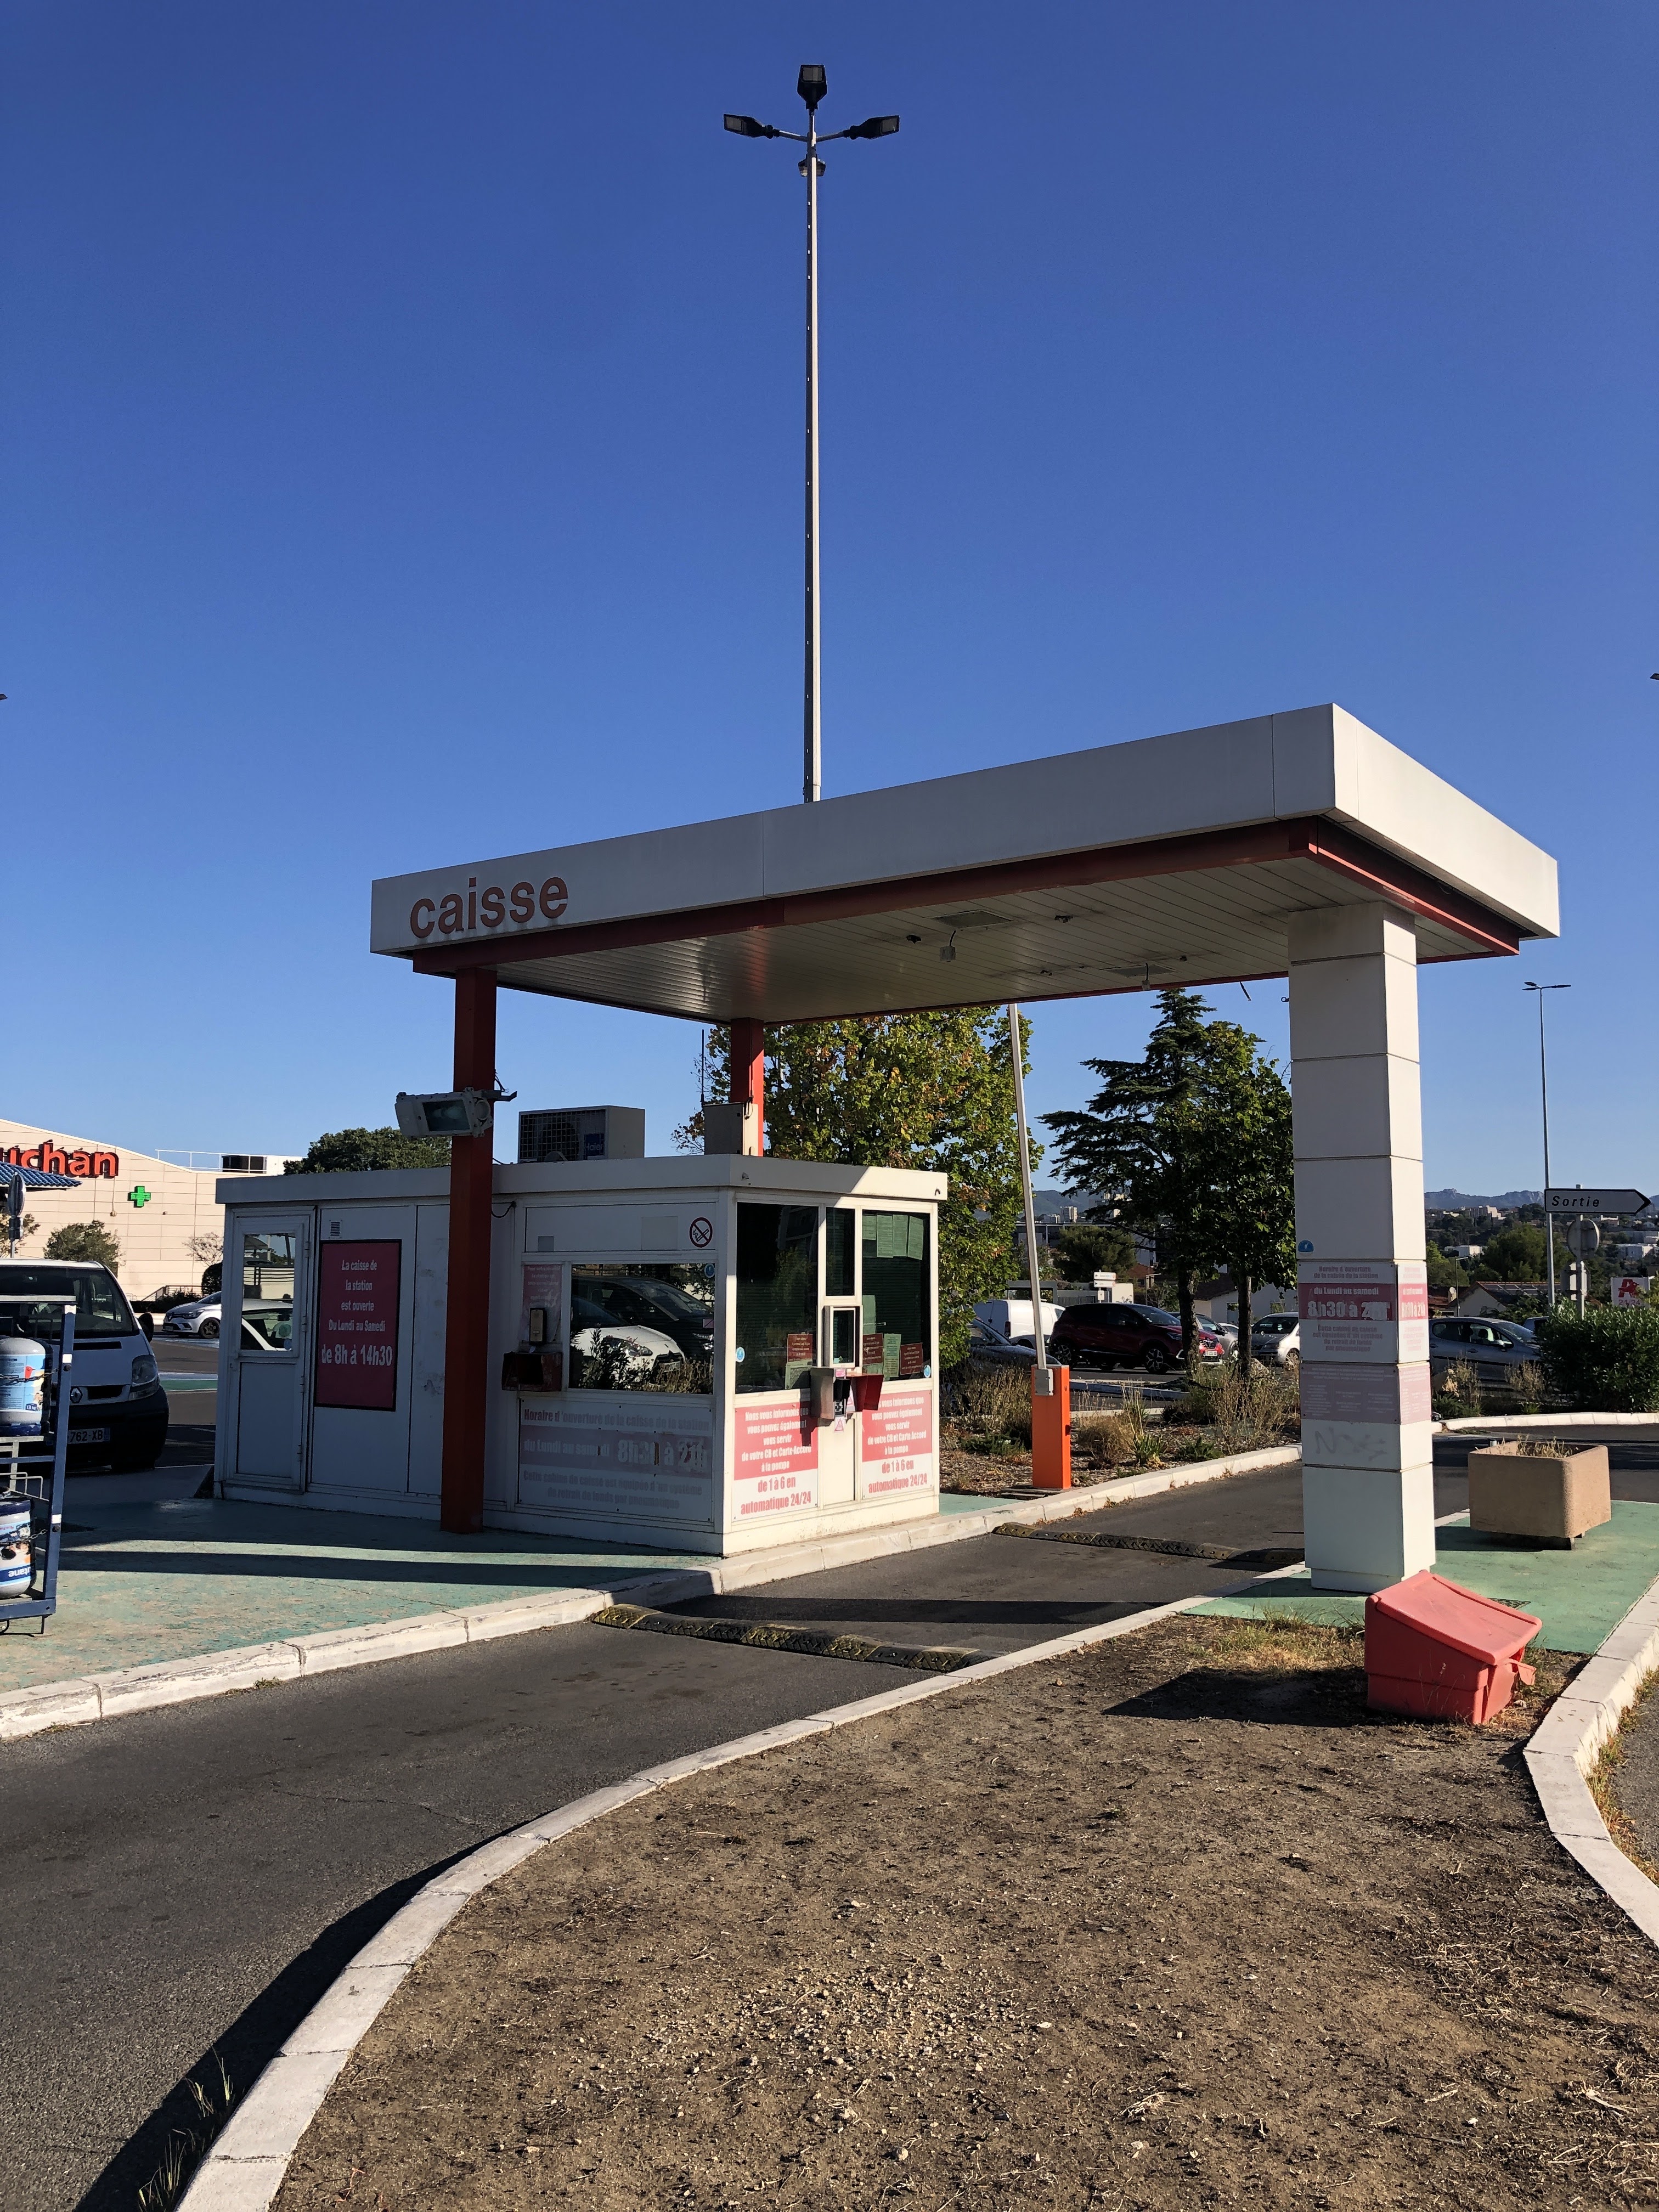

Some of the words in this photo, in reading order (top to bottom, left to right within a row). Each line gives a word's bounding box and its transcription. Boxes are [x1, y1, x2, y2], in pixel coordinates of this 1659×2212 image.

[410, 877, 568, 939] caisse
[1551, 1195, 1599, 1207] Sortie
[341, 1260, 349, 1270] La
[351, 1261, 369, 1270] caisse
[370, 1260, 377, 1270] de
[346, 1279, 351, 1290] la
[352, 1280, 373, 1291] station
[341, 1301, 351, 1311] est
[352, 1301, 374, 1311] ouverte
[1308, 1301, 1345, 1317] 8h30
[1349, 1301, 1358, 1317] à
[329, 1319, 337, 1330] Du
[338, 1319, 354, 1331] Lundi
[356, 1322, 363, 1331] au
[364, 1320, 385, 1331] Samedi
[321, 1344, 332, 1363] de
[335, 1345, 347, 1364] 8h
[350, 1345, 357, 1364] à
[360, 1345, 392, 1366] 14h30
[882, 1399, 893, 1407] vous
[893, 1397, 915, 1406] informons
[916, 1396, 924, 1406] que
[524, 1409, 553, 1421] Horaire
[604, 1413, 614, 1425] de
[617, 1414, 625, 1426] la
[626, 1414, 654, 1427] caisse
[656, 1416, 667, 1429] de
[668, 1417, 677, 1430] la
[678, 1417, 709, 1430] station
[745, 1412, 759, 1421] Nous
[760, 1411, 772, 1420] vous
[774, 1409, 799, 1418] informons
[800, 1407, 809, 1416] que
[872, 1412, 882, 1420] vous
[883, 1410, 899, 1420] pouvez
[900, 1408, 922, 1418] également
[747, 1426, 760, 1435] vous
[761, 1424, 780, 1434] pouvez
[781, 1420, 807, 1431] également
[897, 1421, 910, 1430] servir
[764, 1437, 776, 1446] vous
[777, 1435, 792, 1444] servir
[868, 1436, 873, 1445] de
[874, 1435, 886, 1444] votre
[887, 1434, 893, 1443] CB
[894, 1434, 898, 1442] et
[899, 1432, 911, 1441] Carte
[911, 1430, 927, 1440] Accord
[523, 1439, 535, 1452] du
[537, 1439, 561, 1453] Lundi
[562, 1441, 574, 1454] au
[664, 1441, 674, 1466] à
[742, 1452, 749, 1462] de
[749, 1451, 764, 1460] votre
[765, 1449, 772, 1459] CB
[772, 1448, 778, 1457] et
[884, 1446, 887, 1455] à
[888, 1446, 893, 1454] la
[893, 1445, 909, 1454] pompe
[761, 1463, 765, 1472] à
[766, 1463, 771, 1471] la
[772, 1461, 789, 1471] pompe
[882, 1462, 890, 1474] de
[891, 1461, 895, 1472] 1
[896, 1459, 900, 1472] à
[901, 1459, 905, 1471] 6
[906, 1460, 914, 1470] en
[523, 1470, 542, 1481] Cette
[569, 1474, 578, 1485] de
[580, 1475, 603, 1487] caisse
[758, 1480, 768, 1493] de
[769, 1478, 772, 1491] 1
[774, 1477, 778, 1491] à
[781, 1476, 785, 1489] 6
[787, 1477, 795, 1488] en
[868, 1477, 909, 1493] automatique
[910, 1473, 927, 1487] 24/24
[548, 1487, 557, 1497] de
[582, 1490, 591, 1500] de
[741, 1496, 789, 1515] automatique
[791, 1491, 811, 1506] 24/24
